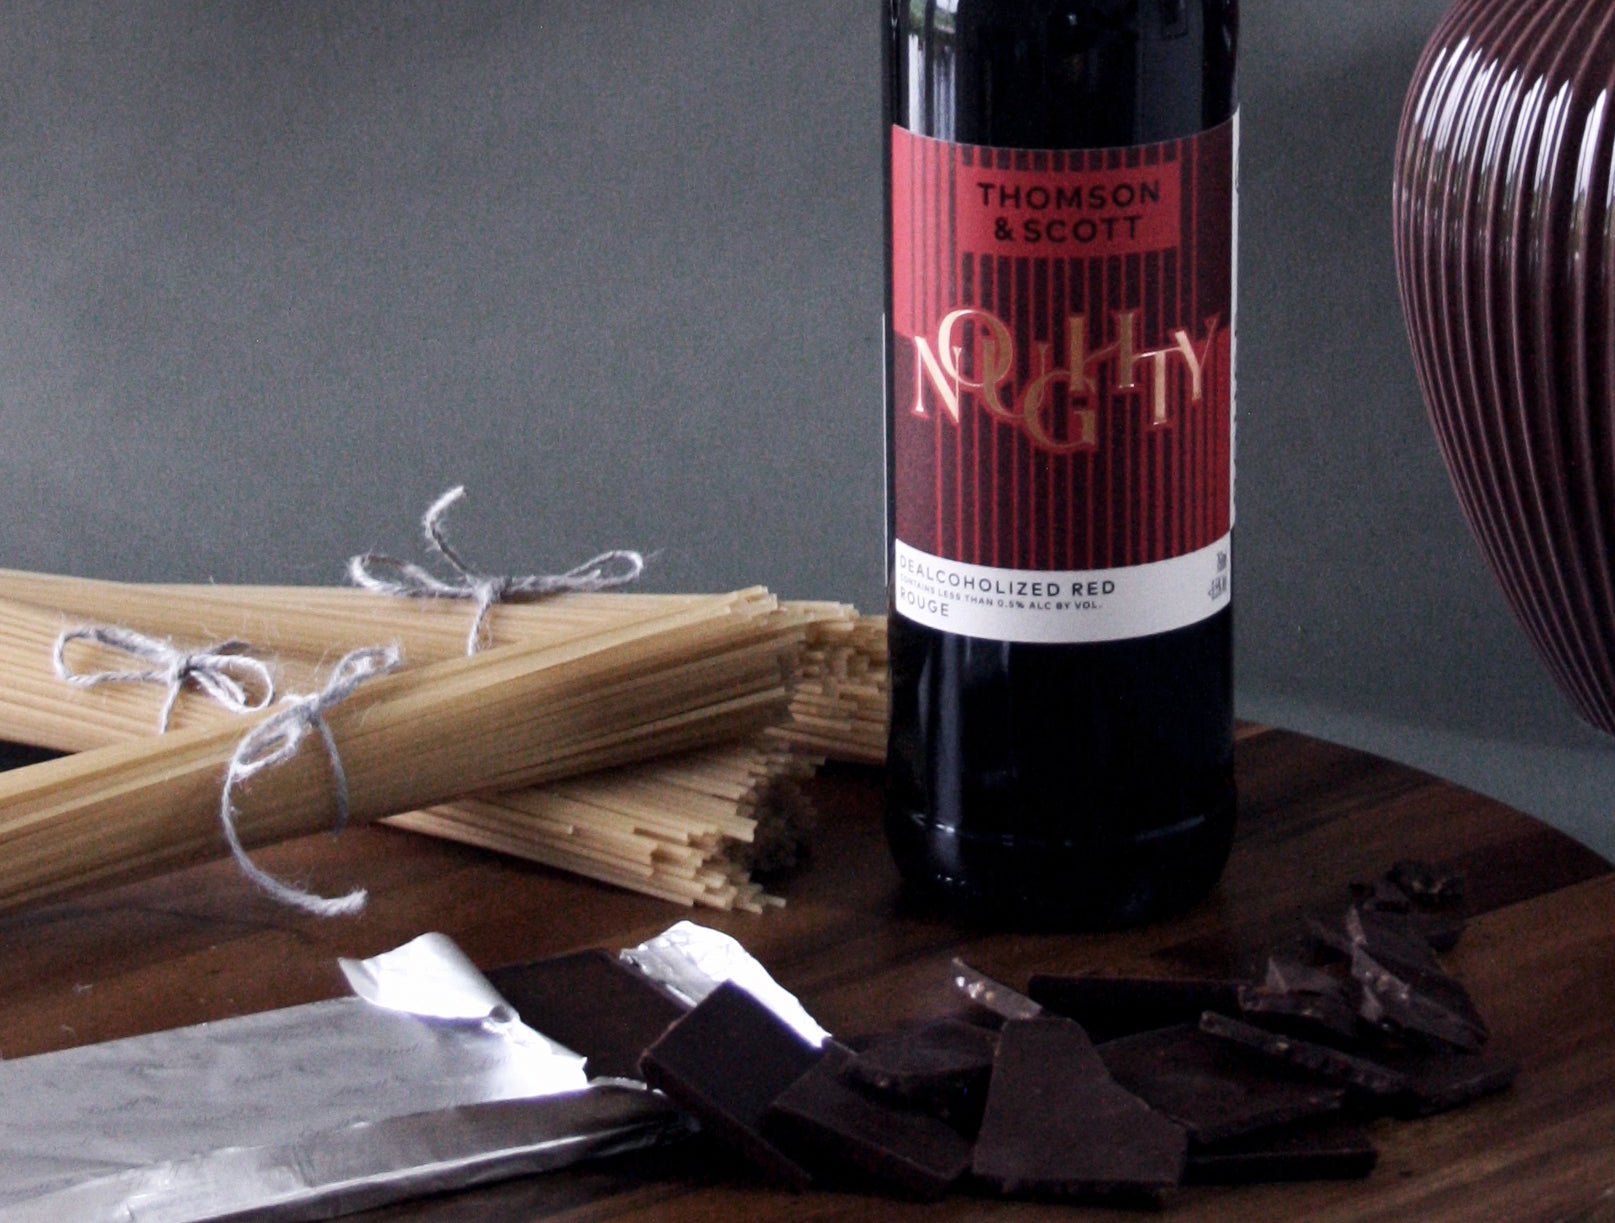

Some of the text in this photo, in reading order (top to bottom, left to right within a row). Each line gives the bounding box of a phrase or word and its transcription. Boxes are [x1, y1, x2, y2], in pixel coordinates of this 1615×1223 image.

[977, 180, 1160, 210] THOMSON
[994, 214, 1143, 243] & SCOTT
[900, 554, 1115, 597] DEALCOHOLIZED RED
[900, 586, 950, 617] ROUGE
[938, 588, 961, 602] LESS
[964, 594, 993, 607] THAN
[997, 599, 1025, 609] 0.5%
[1029, 600, 1051, 610] ALC
[1056, 600, 1070, 610] BY
